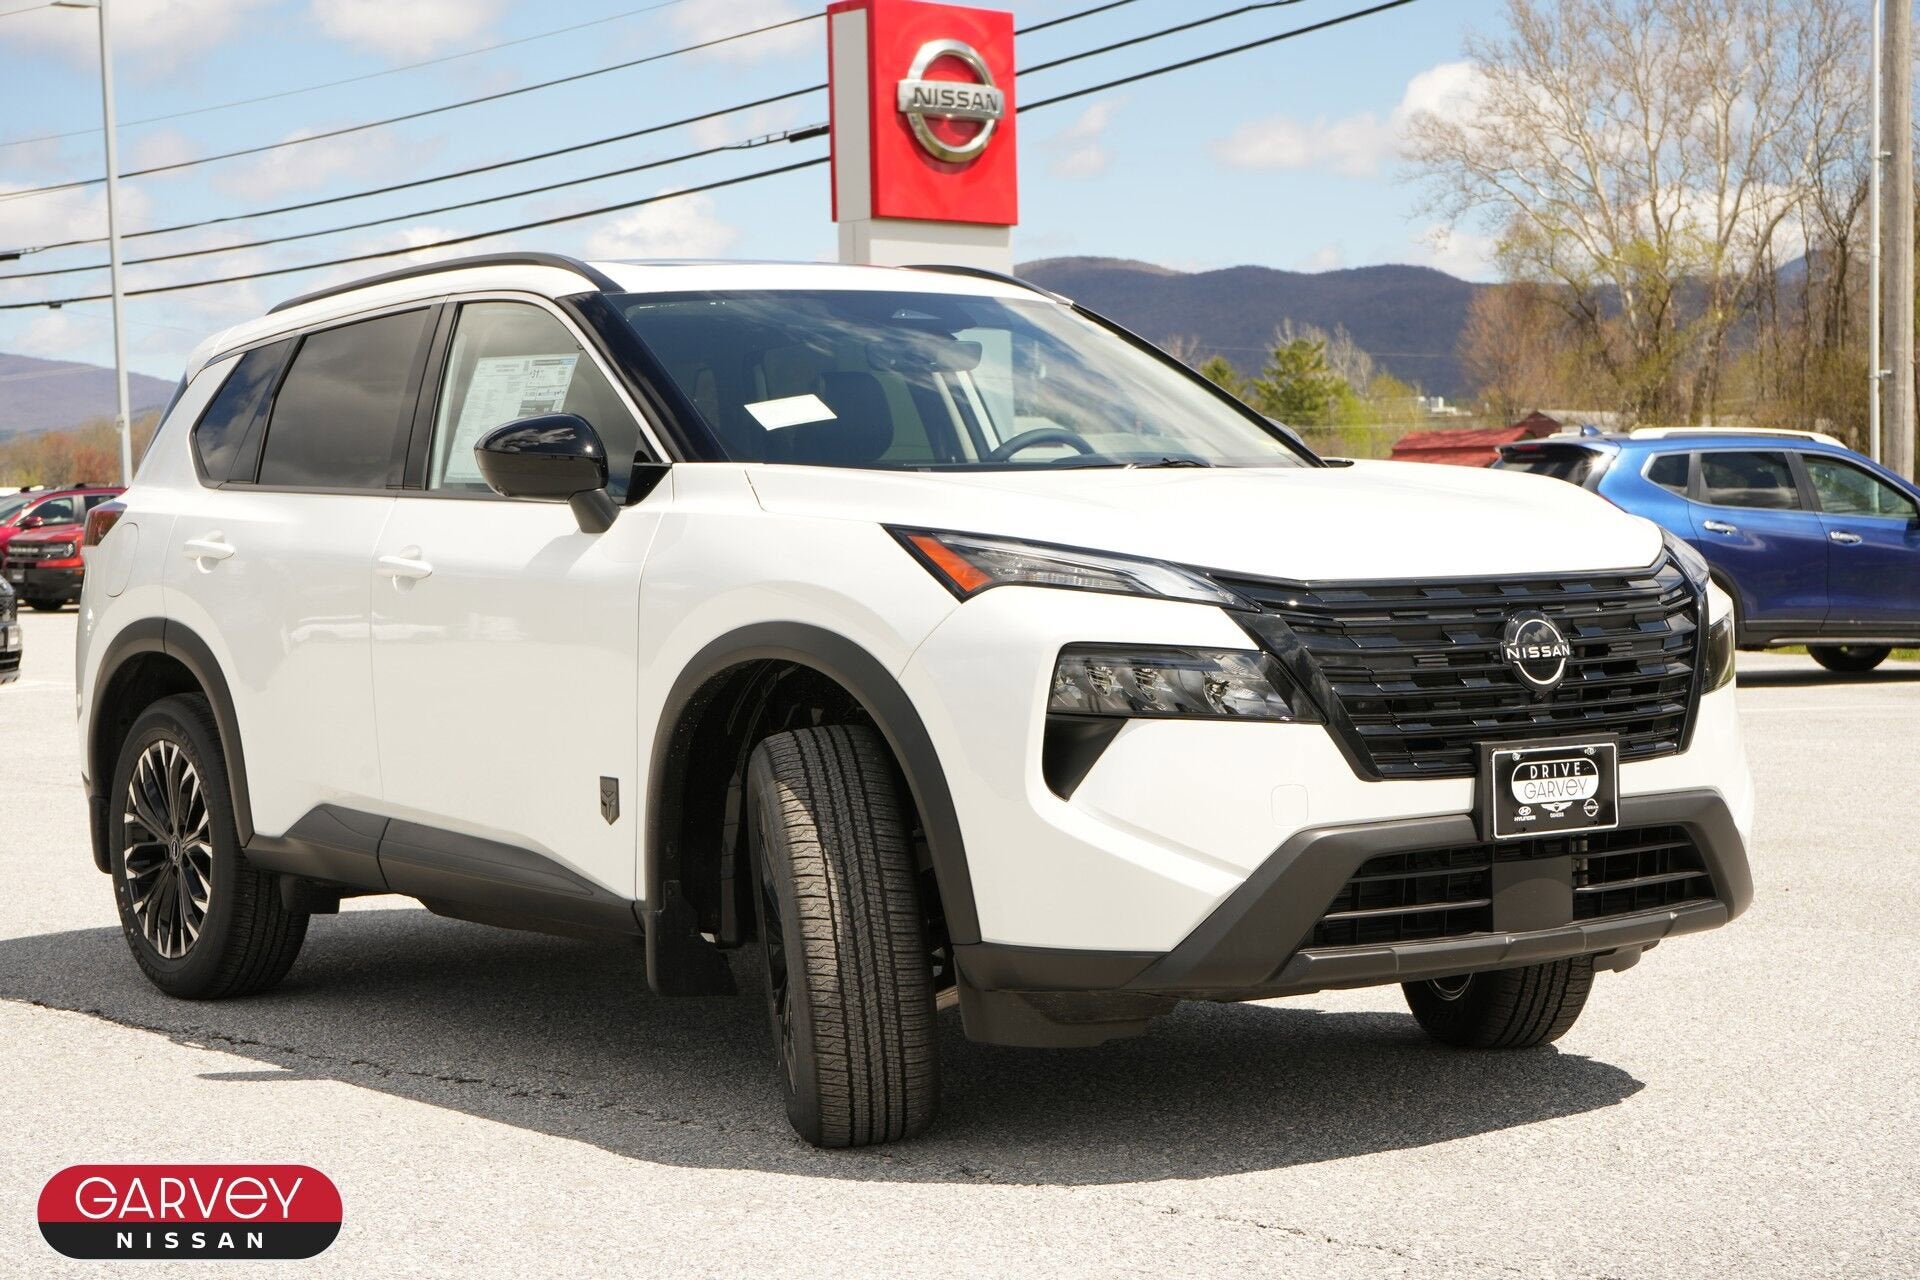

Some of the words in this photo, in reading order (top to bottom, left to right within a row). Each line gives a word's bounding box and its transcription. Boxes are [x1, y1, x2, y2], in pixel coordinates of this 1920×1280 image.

[913, 87, 998, 111] NISSAN
[1506, 644, 1570, 659] NISSAN
[1530, 761, 1581, 779] DRIVE
